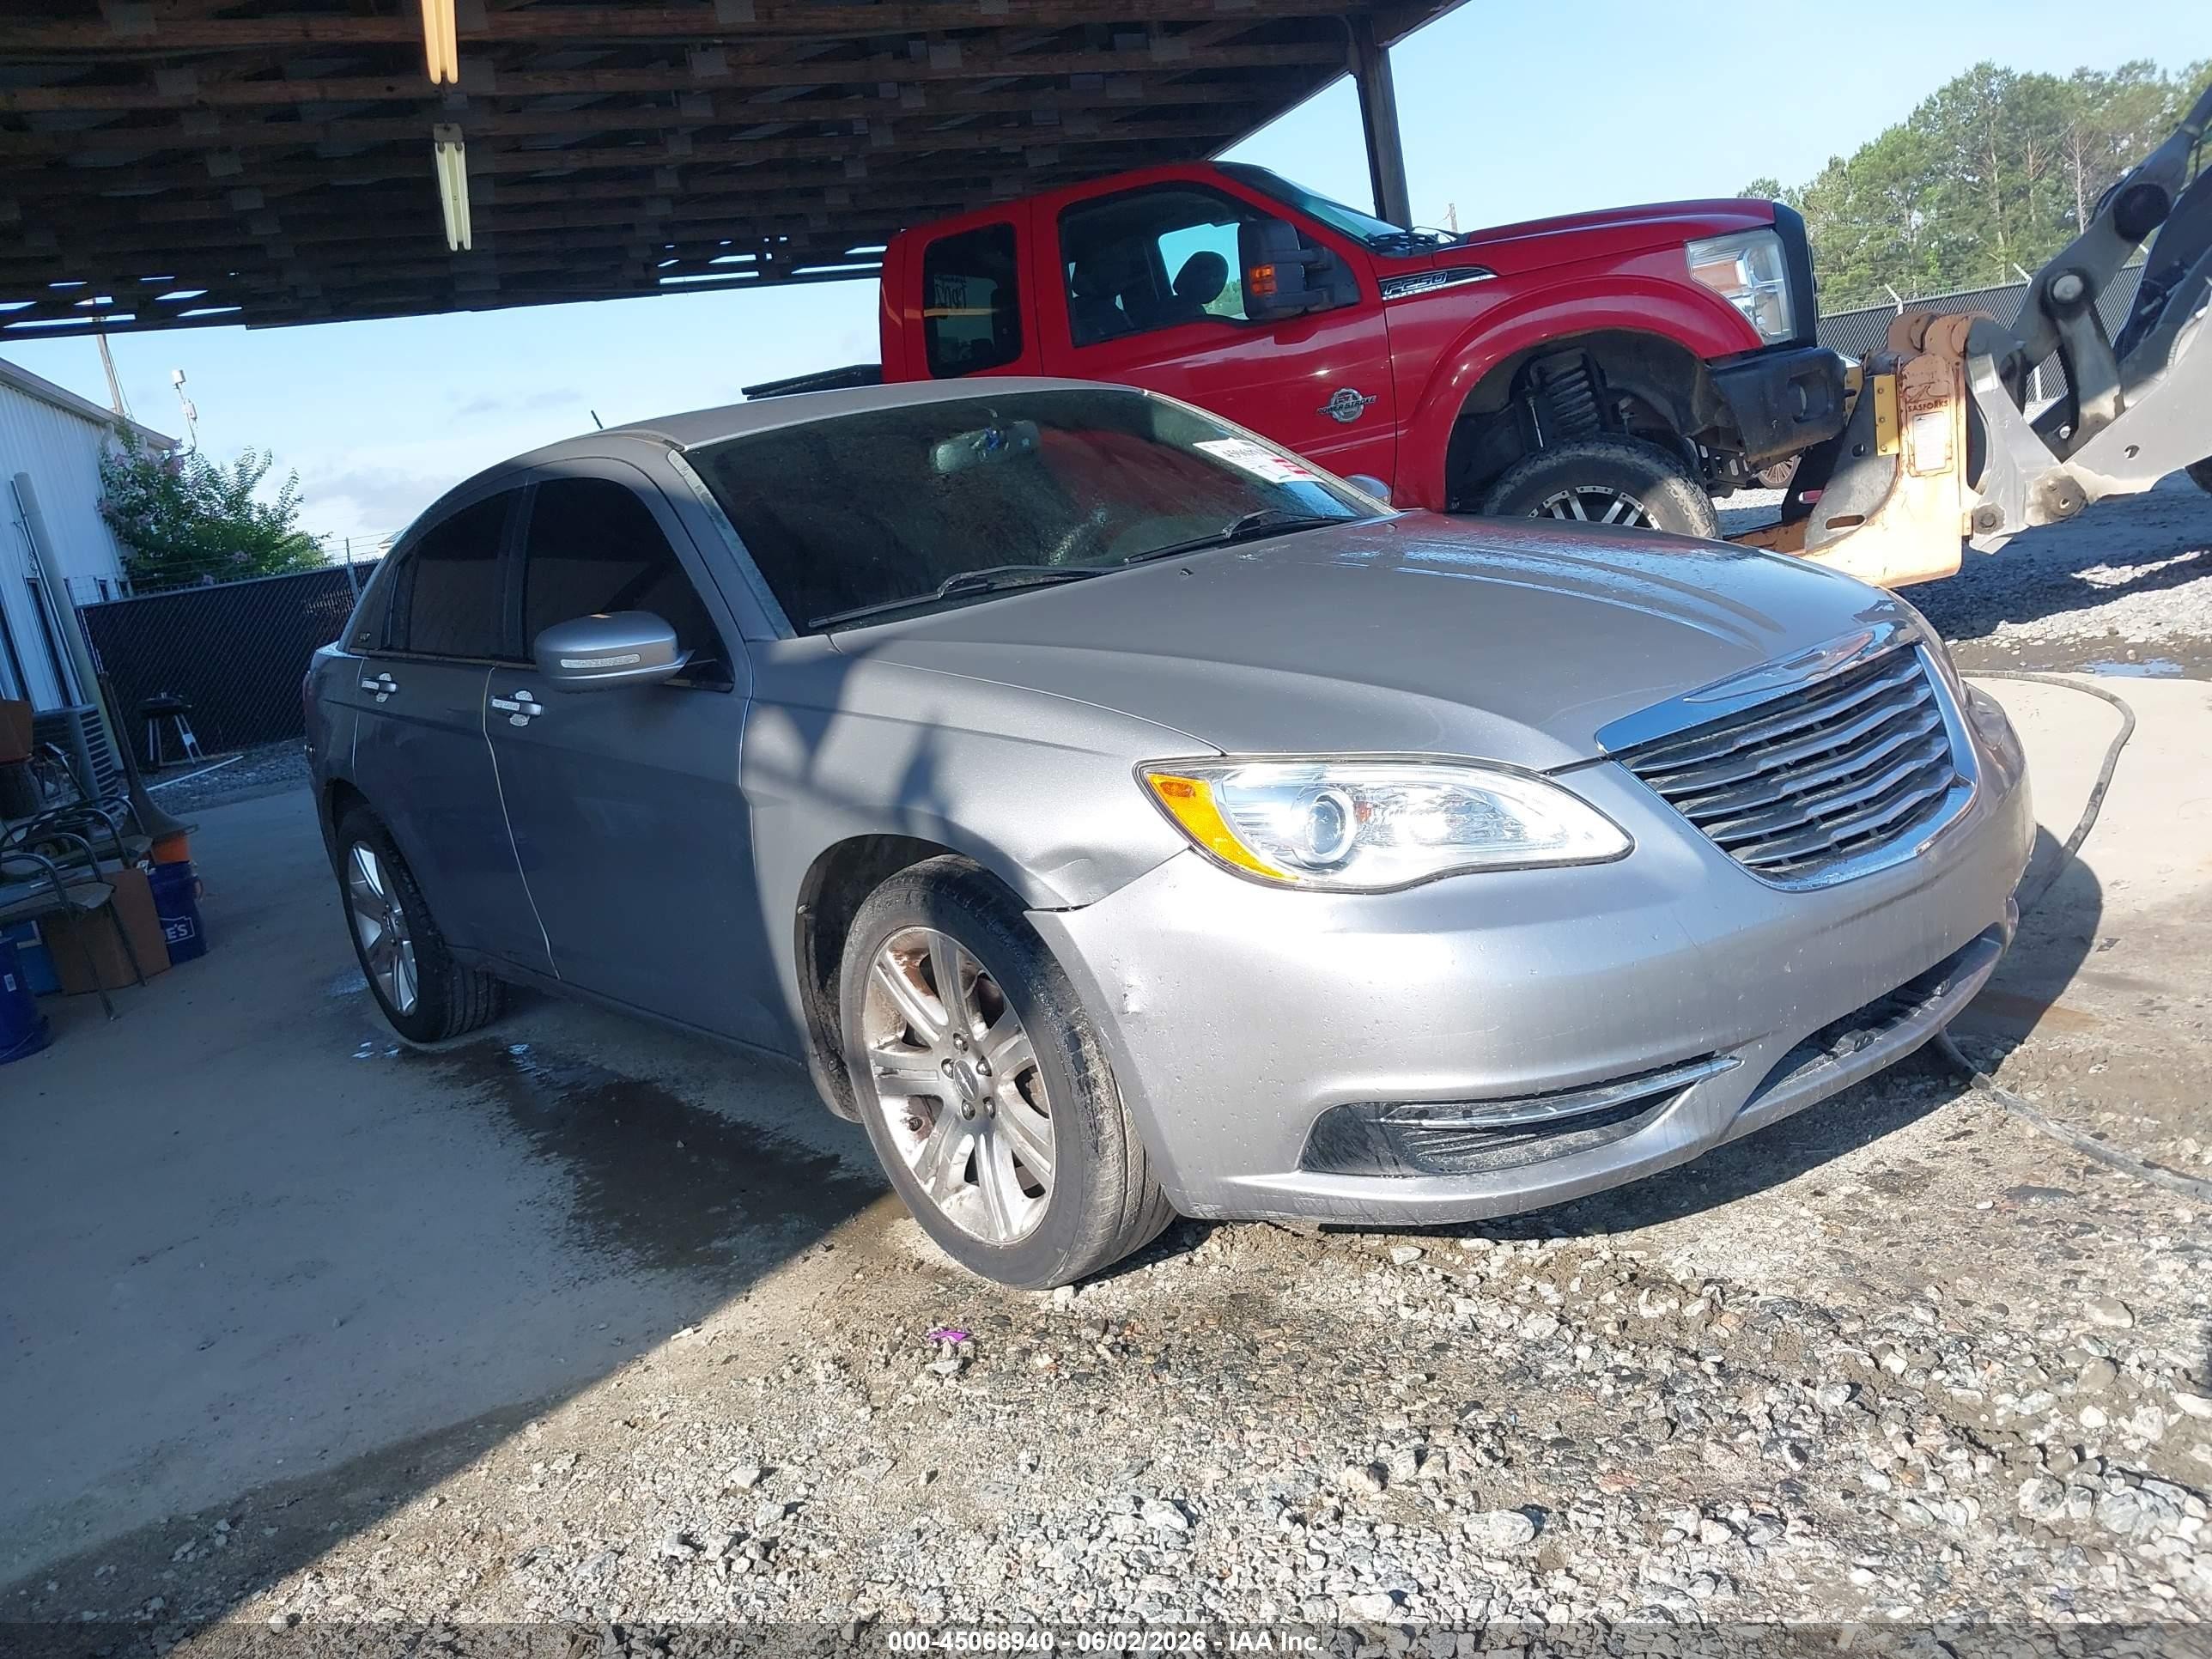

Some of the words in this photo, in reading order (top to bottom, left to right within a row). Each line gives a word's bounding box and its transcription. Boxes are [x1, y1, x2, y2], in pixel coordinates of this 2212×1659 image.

[1317, 404, 1344, 414] POWER
[1344, 395, 1377, 410] STROKE
[1907, 398, 1949, 413] SASFORKS
[165, 922, 188, 940] E'S
